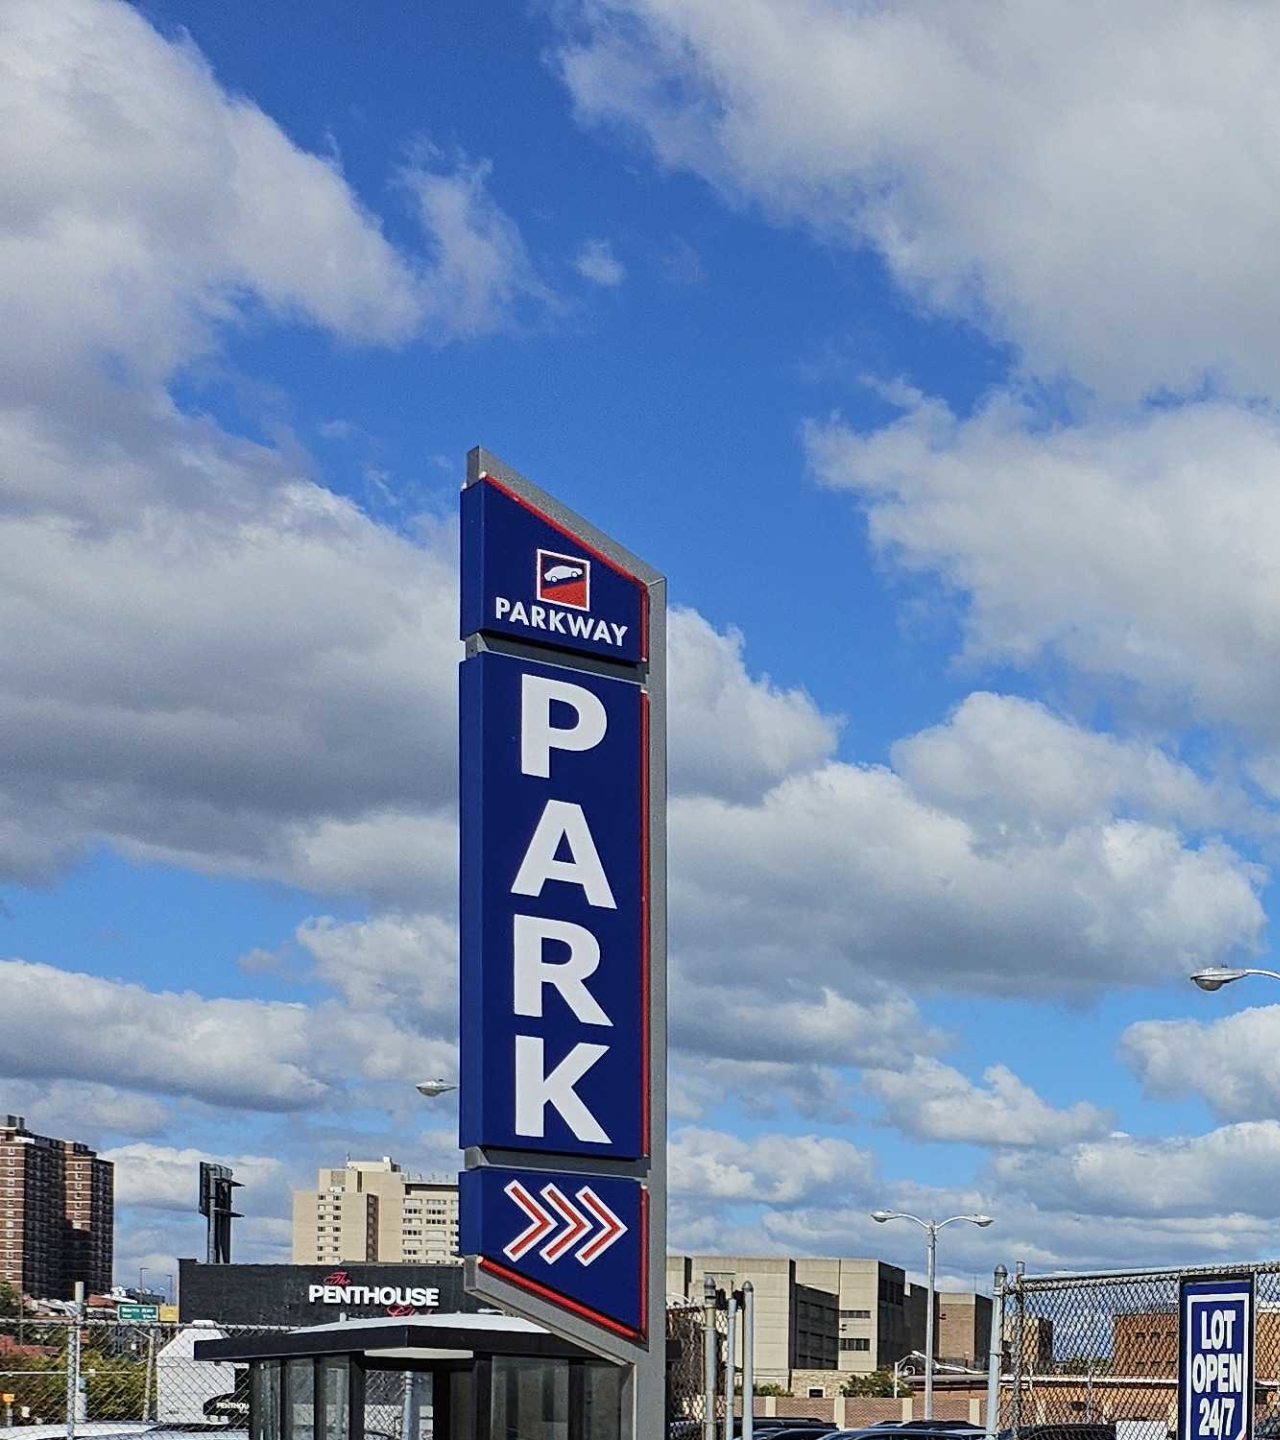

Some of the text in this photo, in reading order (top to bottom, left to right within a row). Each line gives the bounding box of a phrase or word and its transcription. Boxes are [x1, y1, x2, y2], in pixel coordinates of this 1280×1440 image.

[494, 596, 629, 649] PARKWAY
[510, 672, 618, 1145] PARK
[308, 1284, 440, 1307] PENTHOUSE
[323, 1271, 352, 1285] The
[1201, 1309, 1236, 1350] LOT
[1192, 1353, 1242, 1395] OPEN
